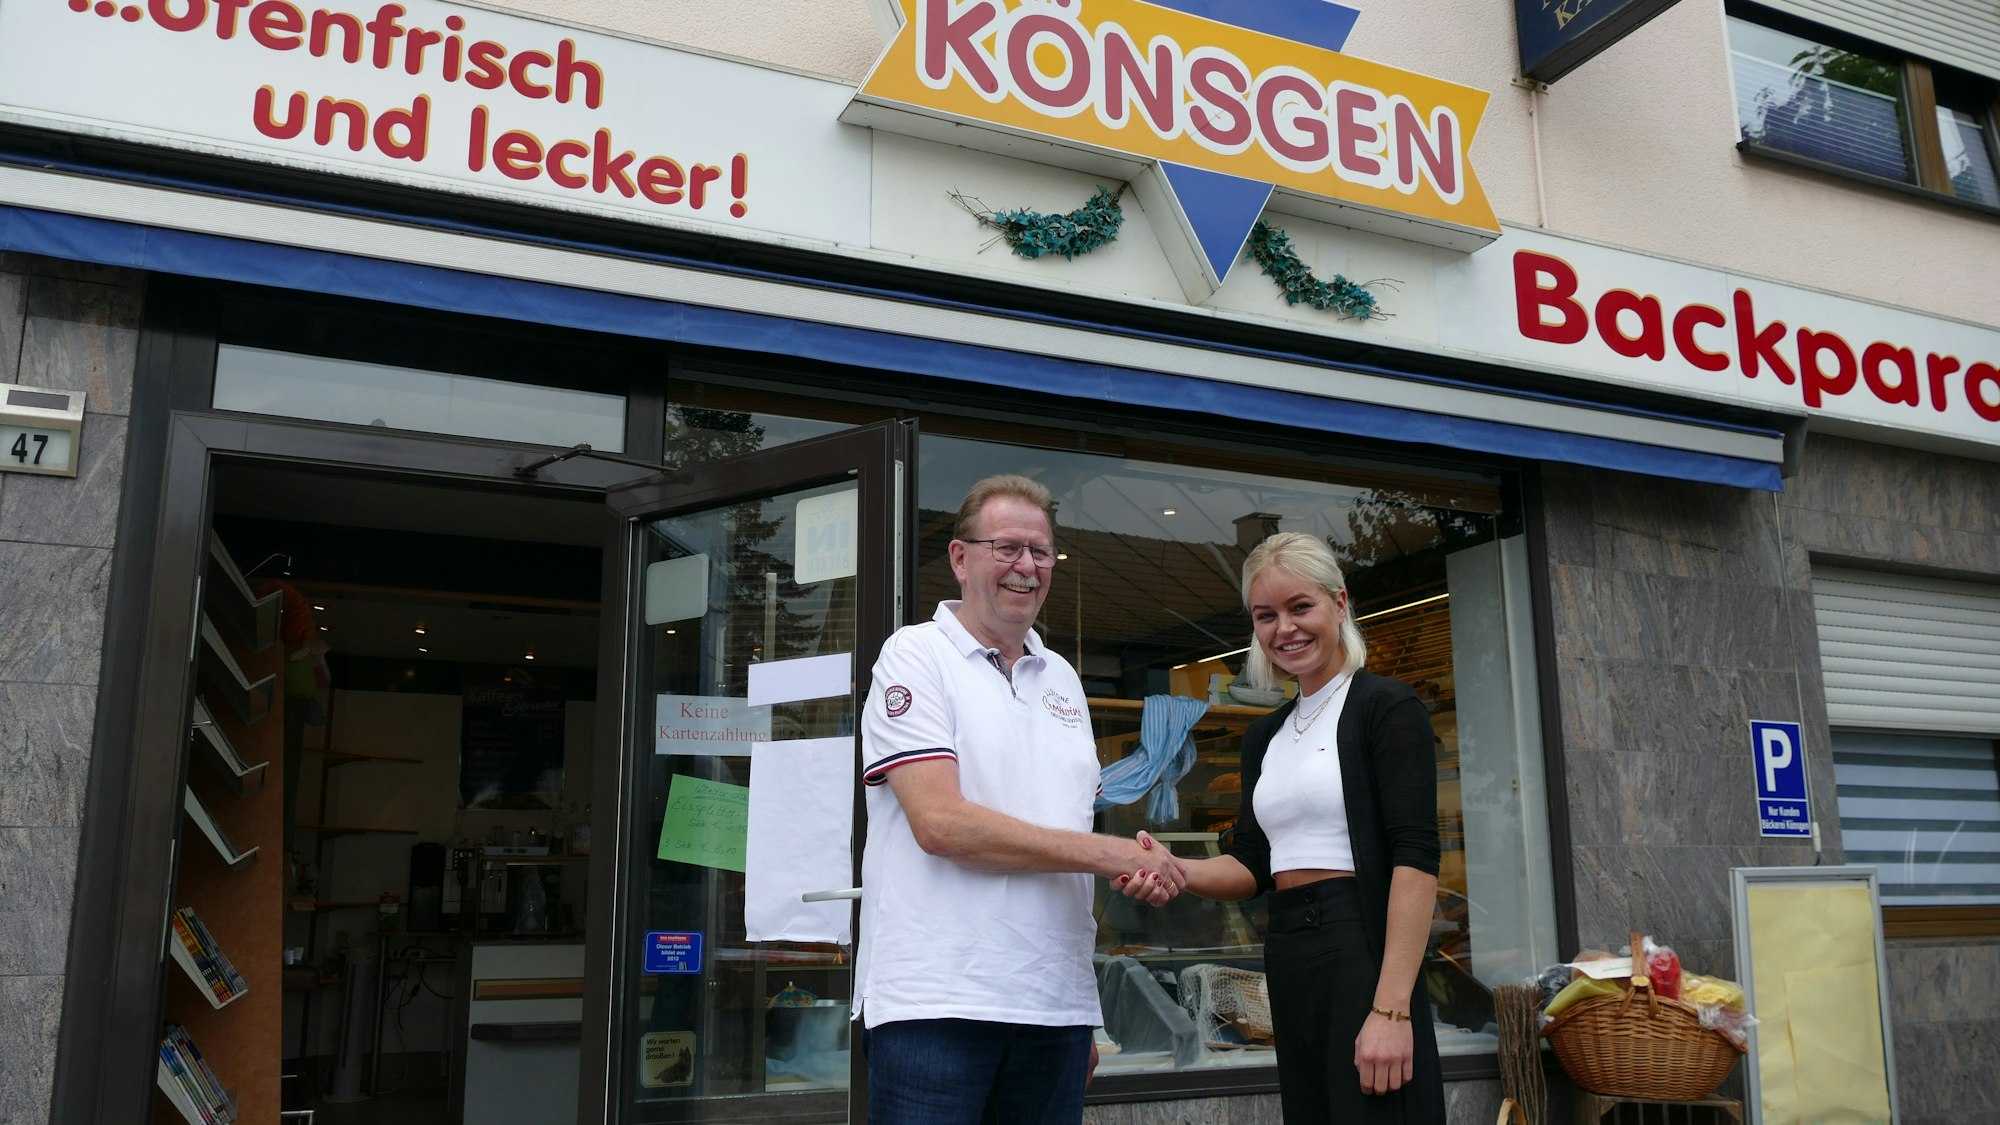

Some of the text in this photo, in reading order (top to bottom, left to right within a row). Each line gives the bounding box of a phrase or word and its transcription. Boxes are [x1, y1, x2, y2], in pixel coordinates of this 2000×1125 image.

[920, 0, 1462, 202] KÖNSGEN
[253, 85, 748, 218] und lecker!
[11, 433, 49, 465] 47
[680, 702, 729, 719] Keine
[659, 725, 767, 742] Kartenzahlung
[1761, 728, 1793, 792] P
[1767, 806, 1801, 817] Nur Kunden
[658, 1037, 681, 1045] warten
